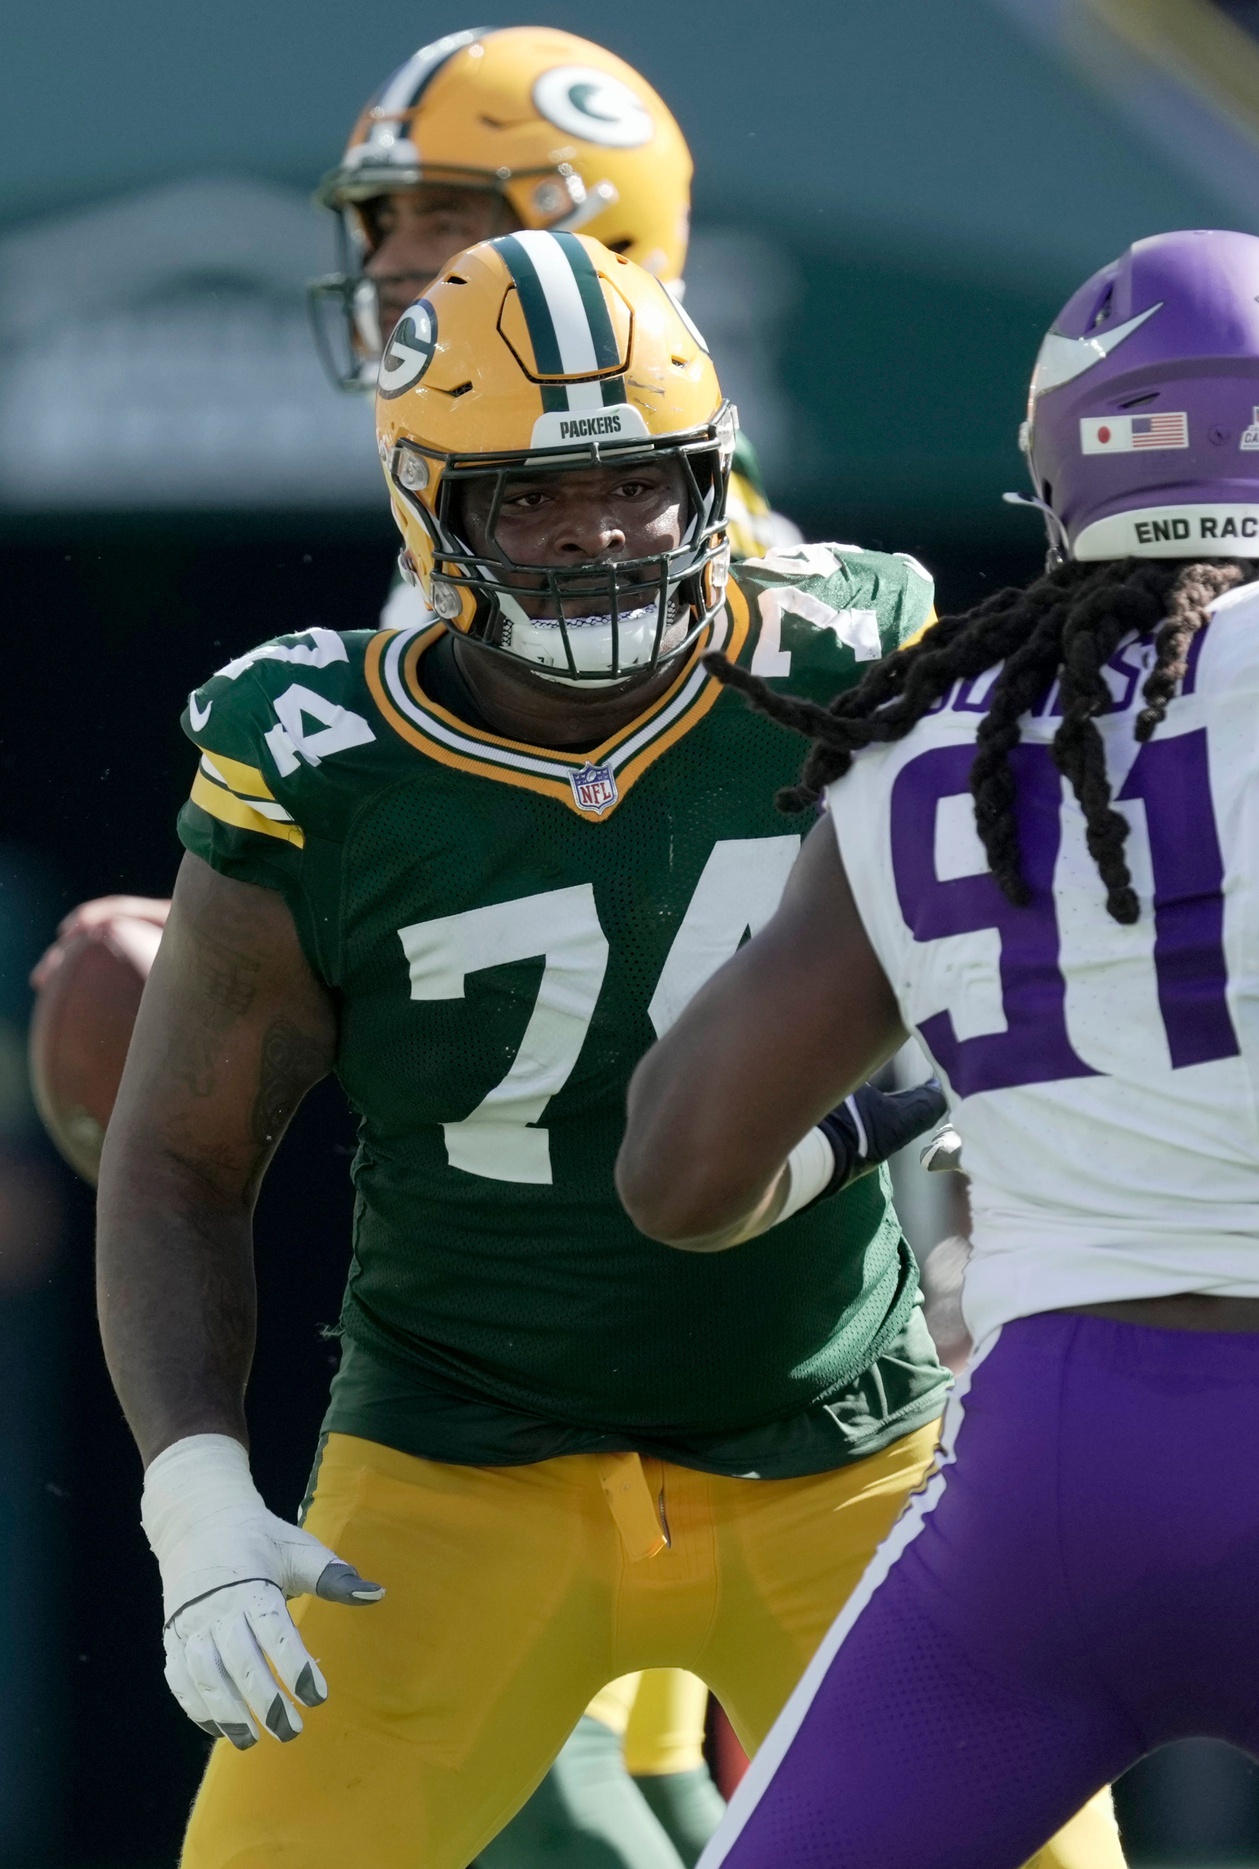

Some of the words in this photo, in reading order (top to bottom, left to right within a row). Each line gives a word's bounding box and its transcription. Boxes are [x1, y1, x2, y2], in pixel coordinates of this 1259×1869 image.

[378, 303, 433, 392] G
[559, 414, 622, 439] PACKERS
[1134, 518, 1190, 544] END
[212, 626, 377, 778] 74
[579, 781, 612, 805] NFL
[890, 726, 1242, 1102] 91
